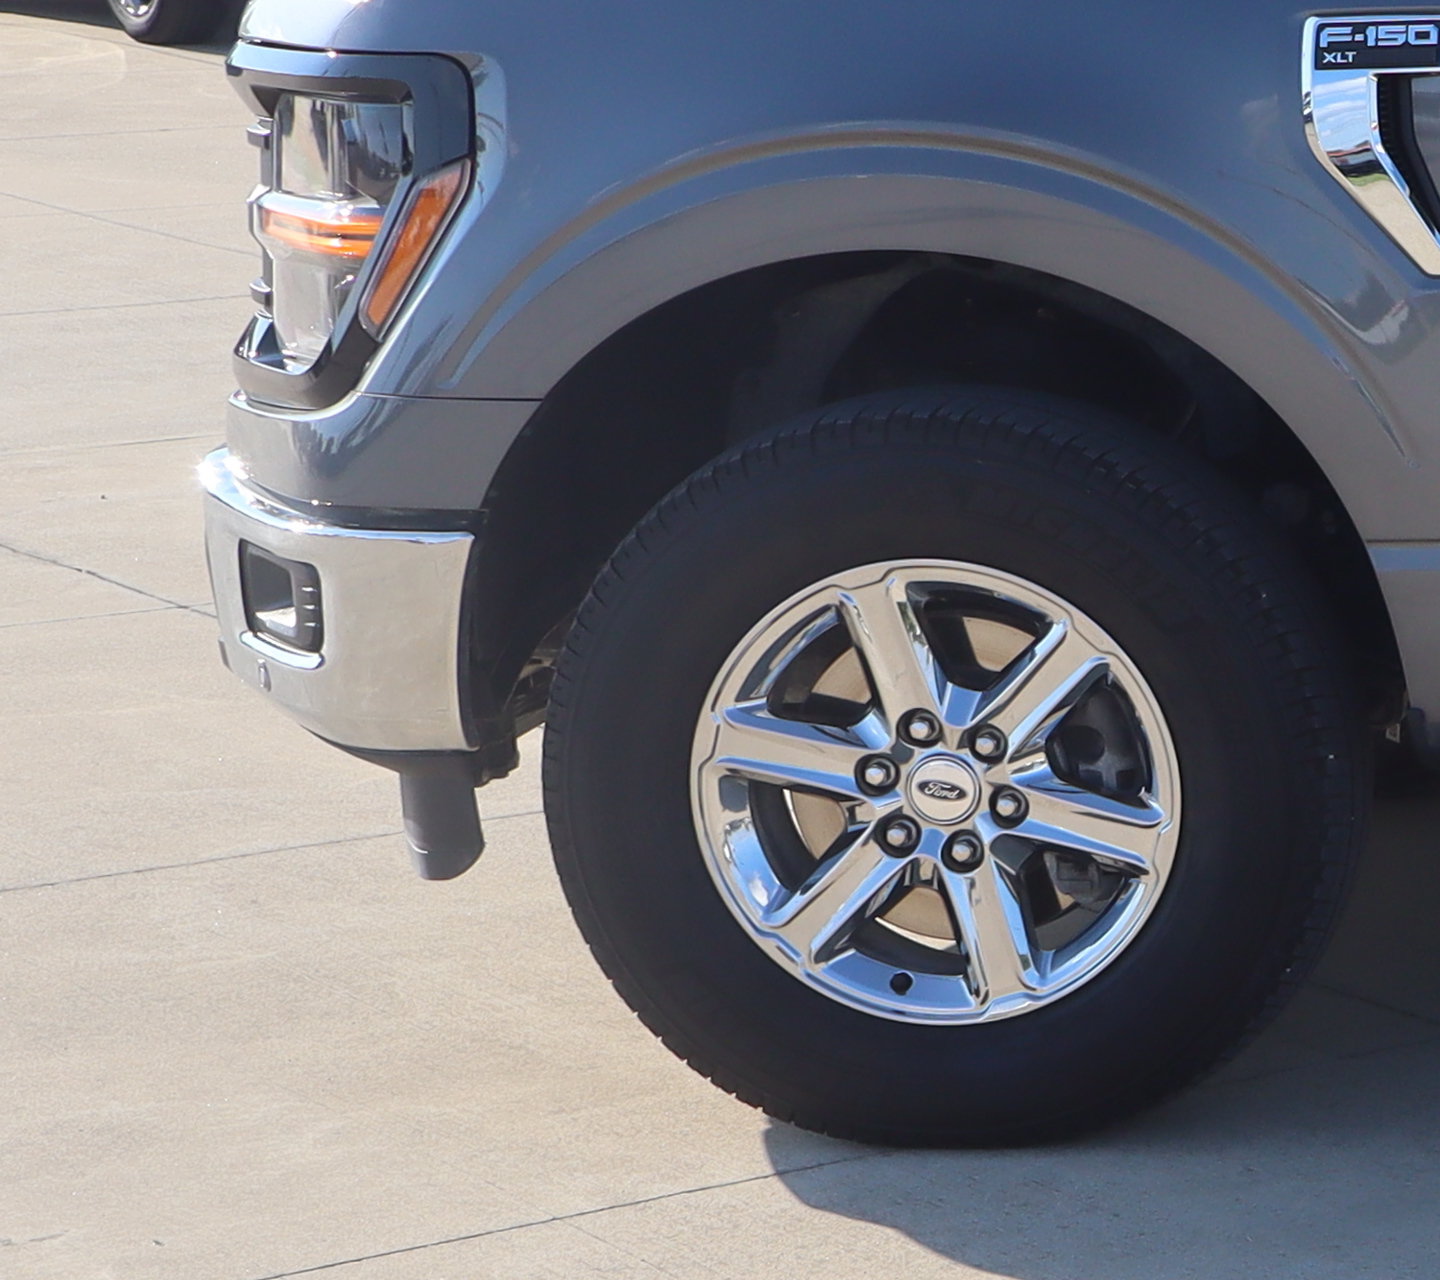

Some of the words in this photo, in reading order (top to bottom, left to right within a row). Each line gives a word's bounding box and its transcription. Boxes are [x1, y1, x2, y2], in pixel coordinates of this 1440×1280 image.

[1318, 24, 1439, 48] F-150
[1322, 51, 1357, 64] XLT
[924, 781, 960, 799] Ford
